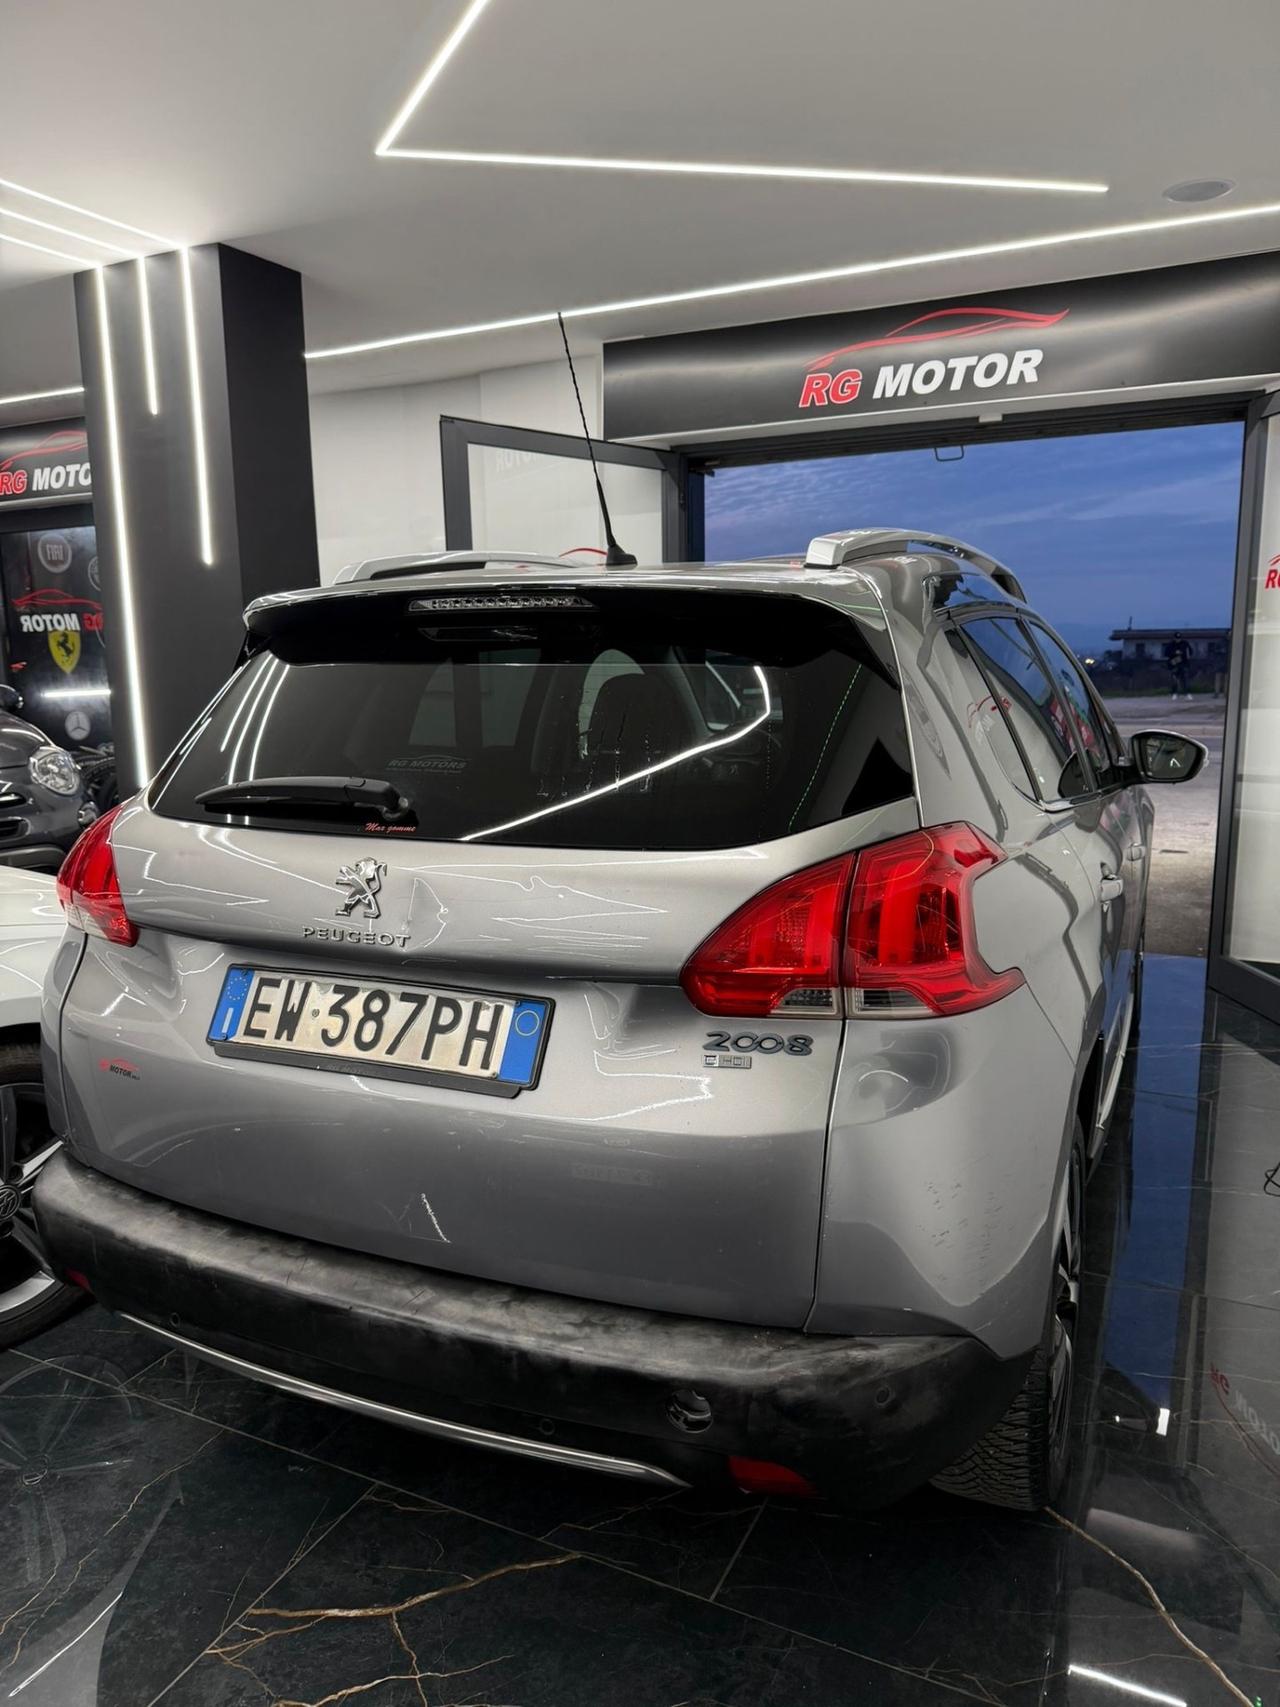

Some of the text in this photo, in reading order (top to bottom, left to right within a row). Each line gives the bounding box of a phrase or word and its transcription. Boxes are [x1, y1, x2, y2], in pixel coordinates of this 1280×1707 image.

[799, 349, 1043, 408] RG MOTOR
[0, 469, 28, 496] RG
[1265, 568, 1280, 590] R
[302, 926, 411, 948] PEUGEOT
[702, 1030, 814, 1056] 2008
